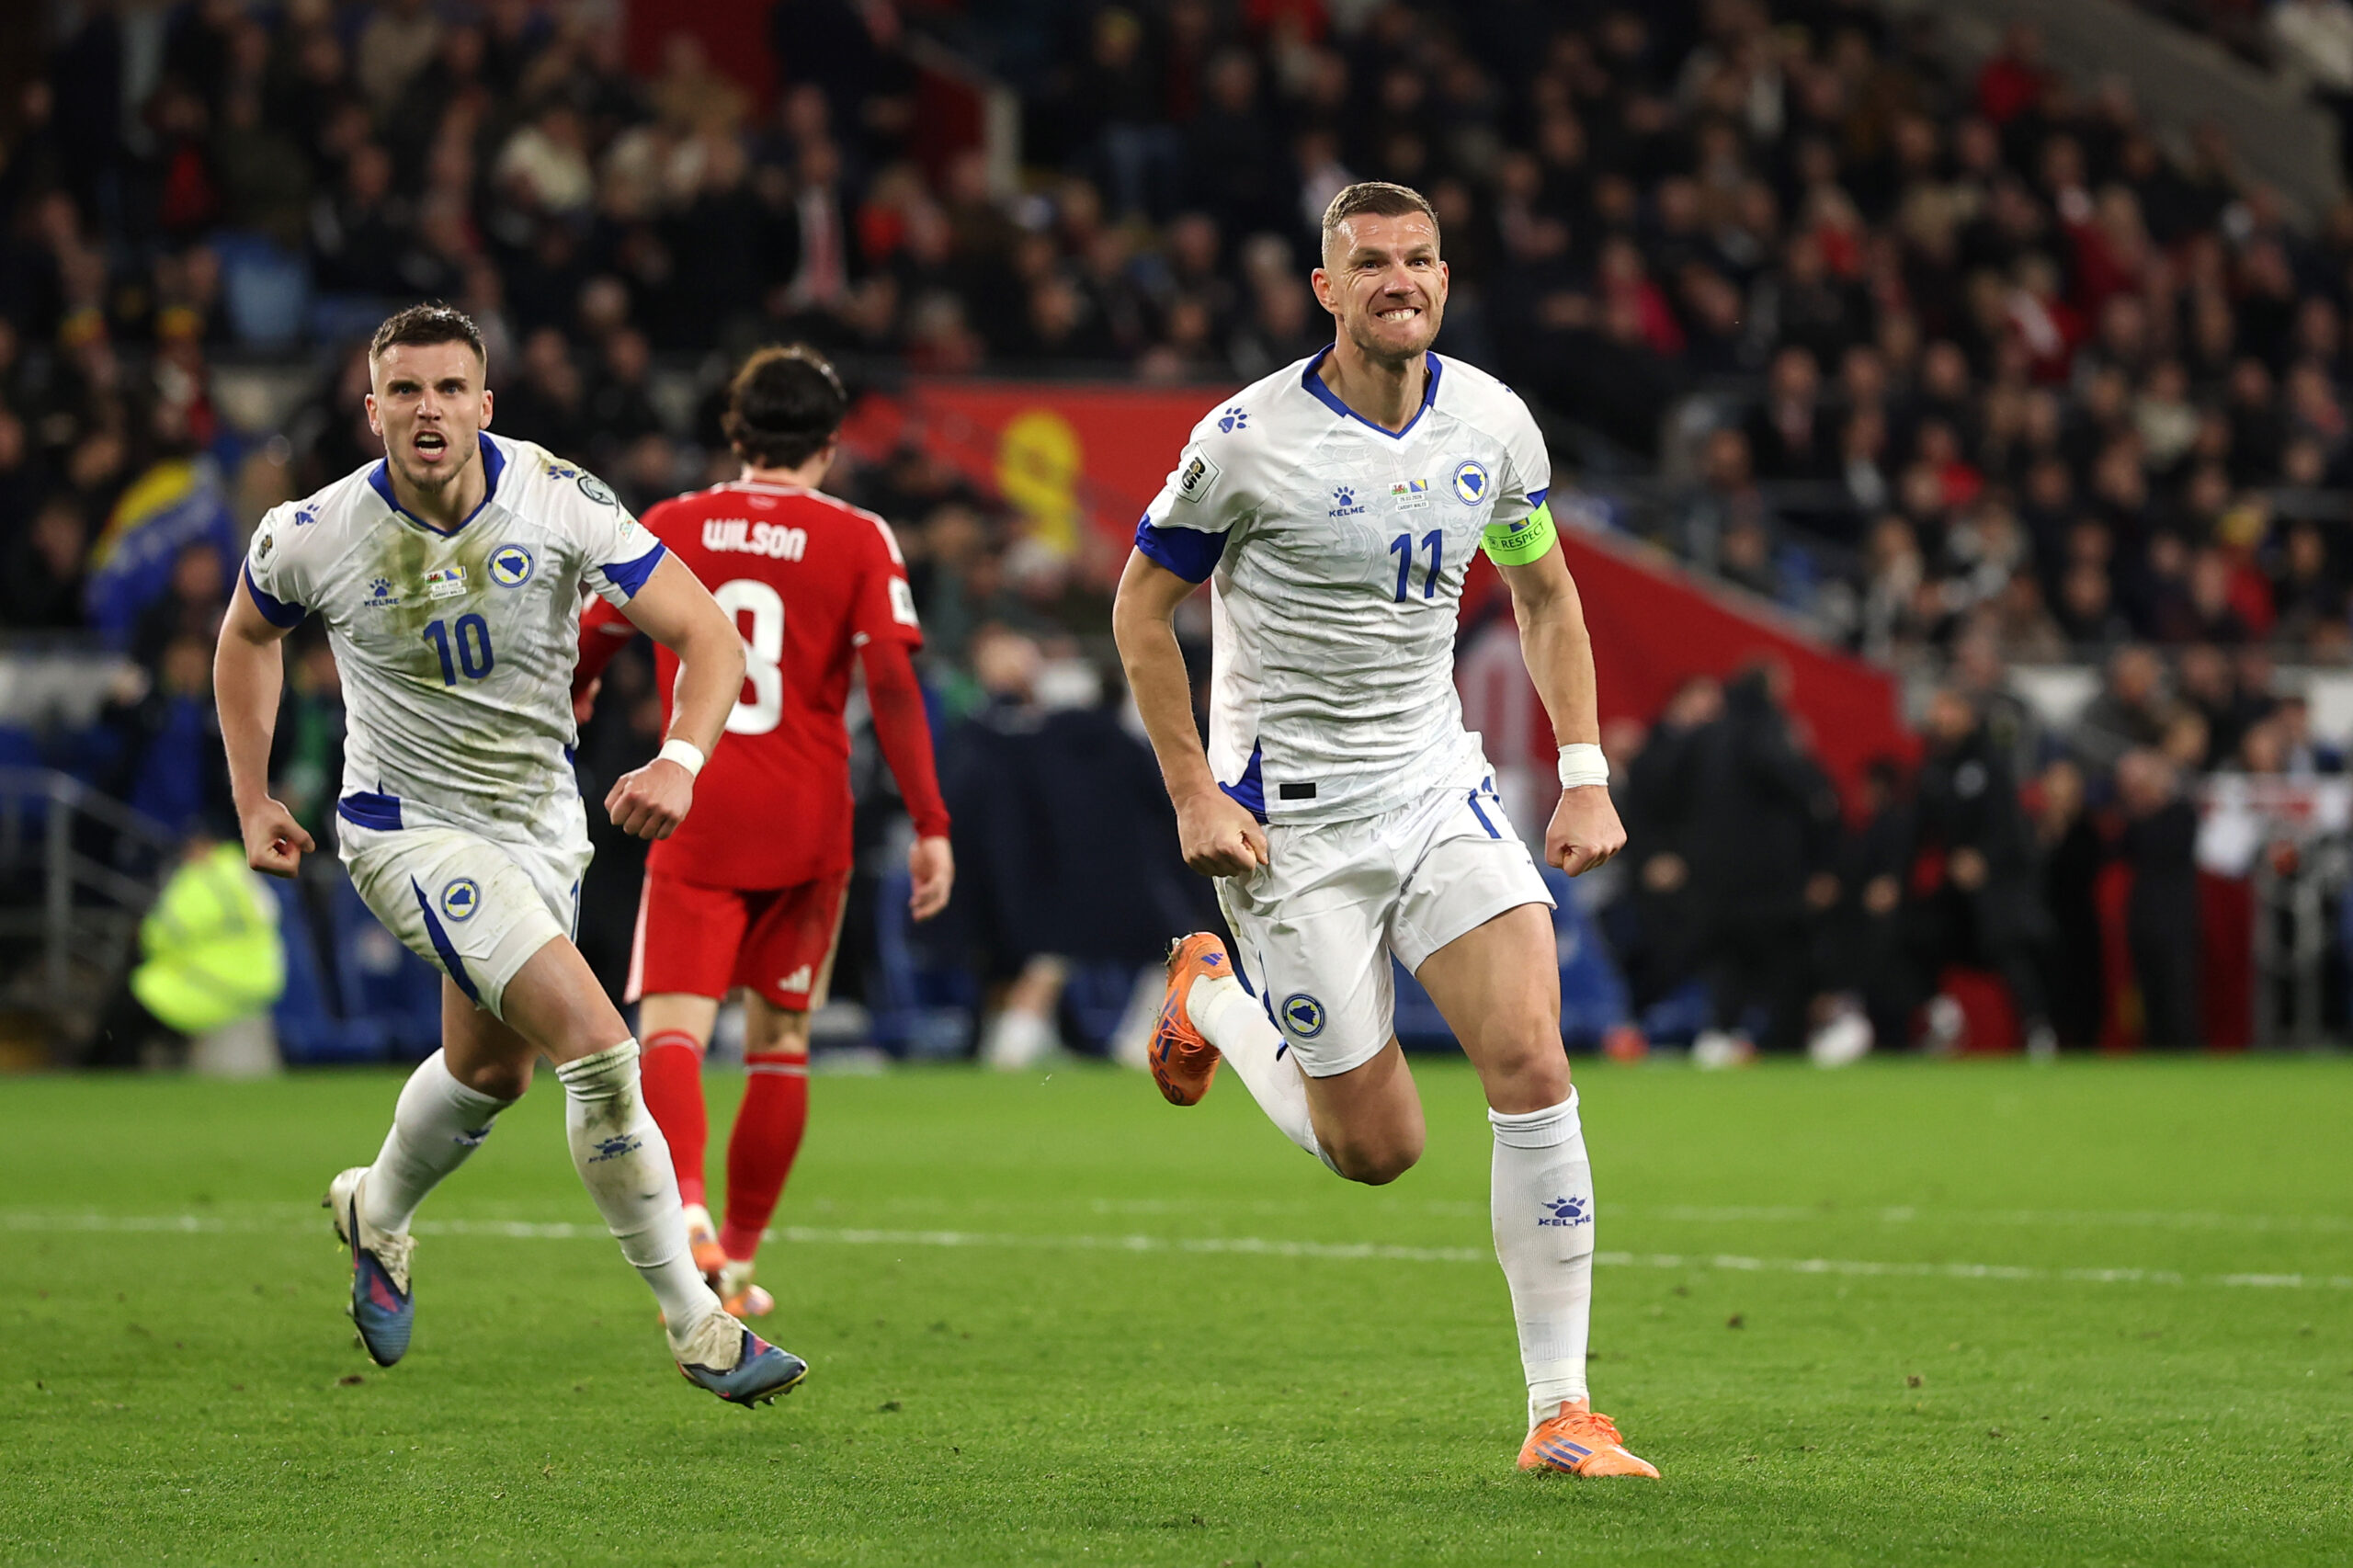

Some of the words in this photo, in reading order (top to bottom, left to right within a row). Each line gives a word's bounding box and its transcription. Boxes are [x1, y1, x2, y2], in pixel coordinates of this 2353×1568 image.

[1329, 506, 1366, 517] KELME
[701, 518, 808, 562] WILSON
[1501, 521, 1545, 549] RESPECT
[1390, 528, 1442, 603] 11
[364, 597, 400, 607] KELME
[423, 613, 494, 687] 10
[712, 578, 785, 735] 8
[1538, 1214, 1592, 1227] KELME
